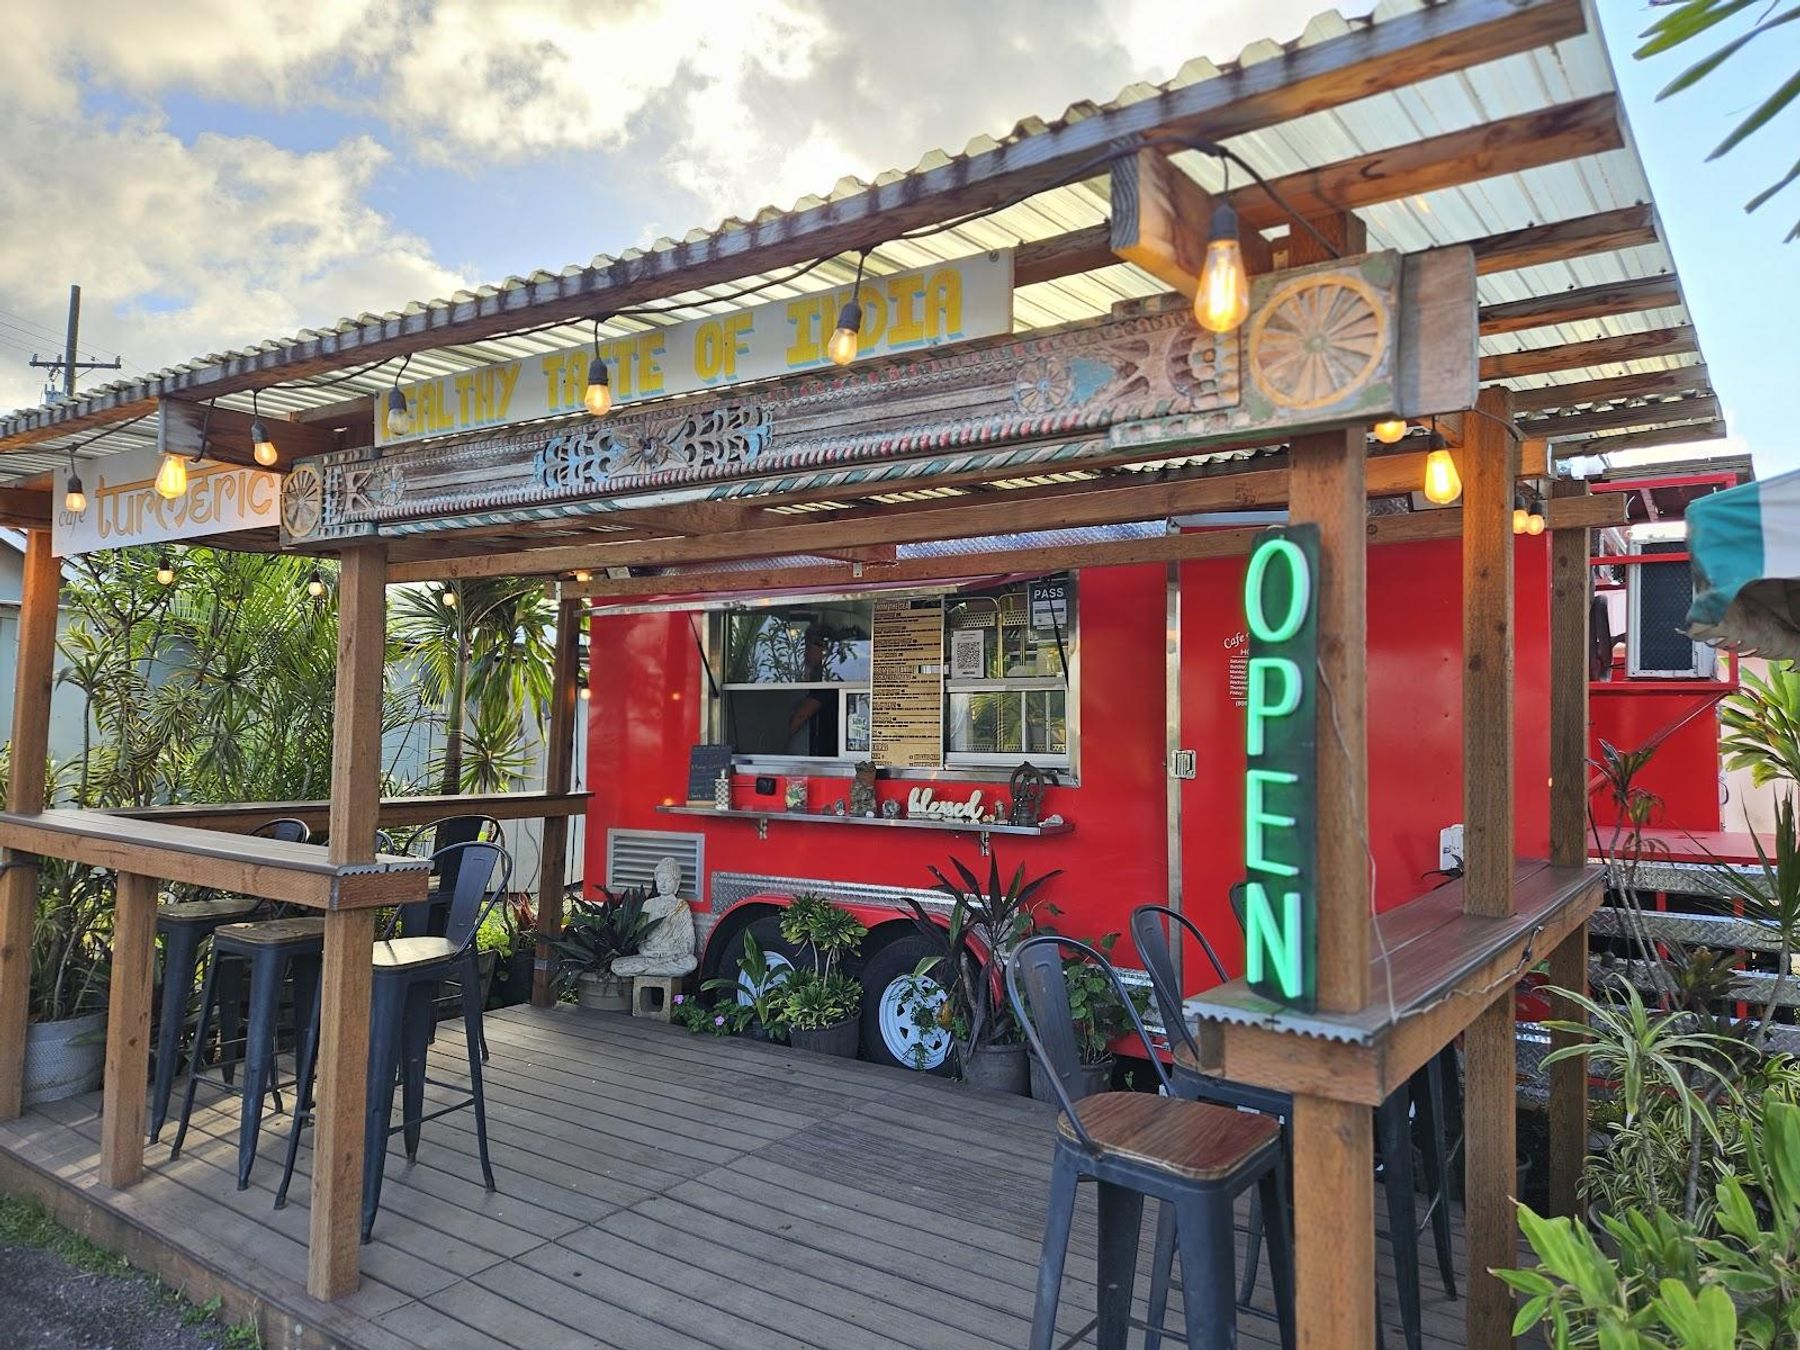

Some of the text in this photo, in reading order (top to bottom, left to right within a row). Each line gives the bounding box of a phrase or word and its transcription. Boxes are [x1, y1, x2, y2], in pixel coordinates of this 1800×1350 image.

[543, 333, 666, 412] TATE
[694, 312, 754, 383] OF
[1034, 587, 1065, 599] PASS
[1223, 632, 1245, 649] Cafe
[1245, 538, 1310, 998] OPEN
[907, 786, 985, 818] blessed
